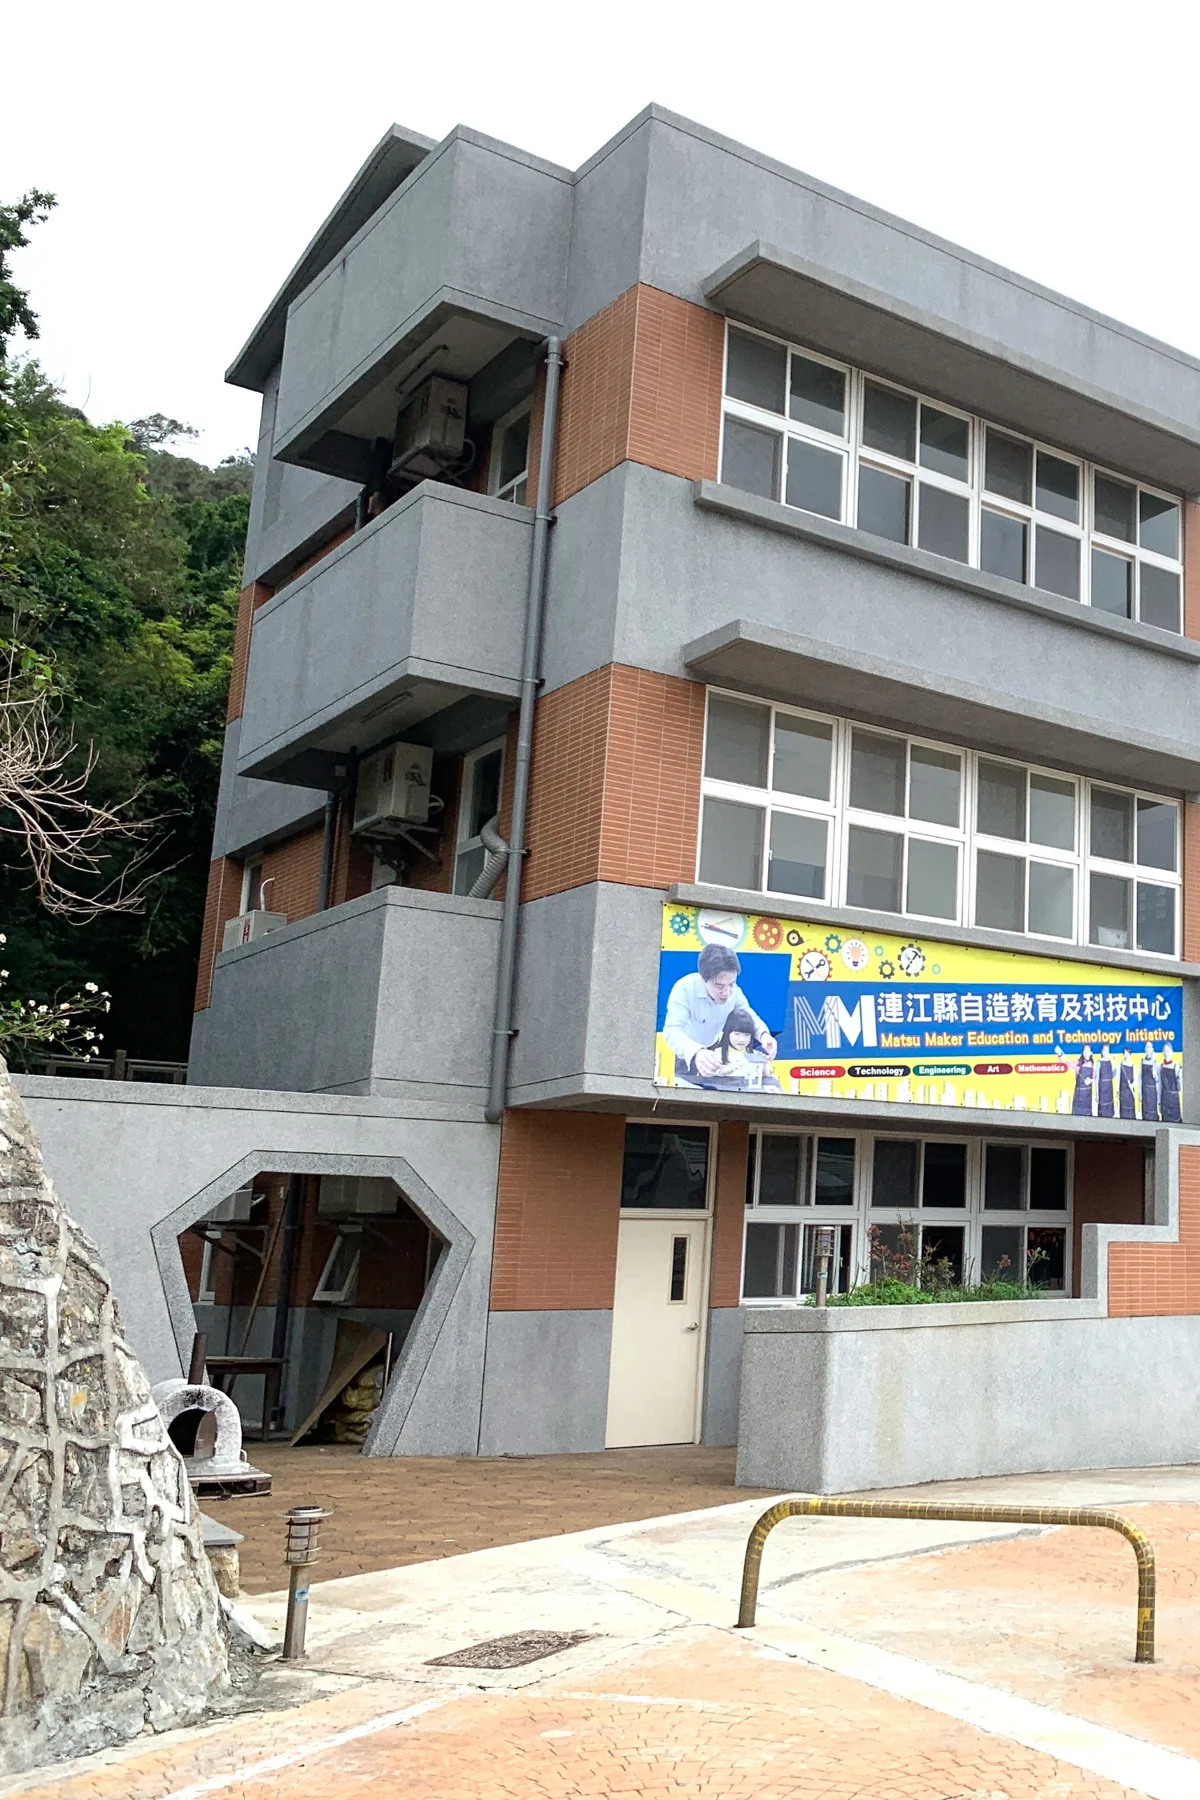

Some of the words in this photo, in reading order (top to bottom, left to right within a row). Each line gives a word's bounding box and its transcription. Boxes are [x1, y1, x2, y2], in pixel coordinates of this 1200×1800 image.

[877, 992, 1172, 1023] 連江縣自造教育及科技中心
[881, 1033, 920, 1047] Matsu
[925, 1032, 963, 1046] Maker
[967, 1031, 1029, 1046] Education
[1033, 1031, 1053, 1044] and
[1057, 1029, 1122, 1044] Technology
[1126, 1028, 1175, 1041] Initiative
[800, 1067, 836, 1076] Science
[855, 1067, 904, 1077] Technology
[918, 1065, 967, 1075] Engineering
[987, 1064, 999, 1073] Art
[1018, 1063, 1065, 1072] Mathematics
